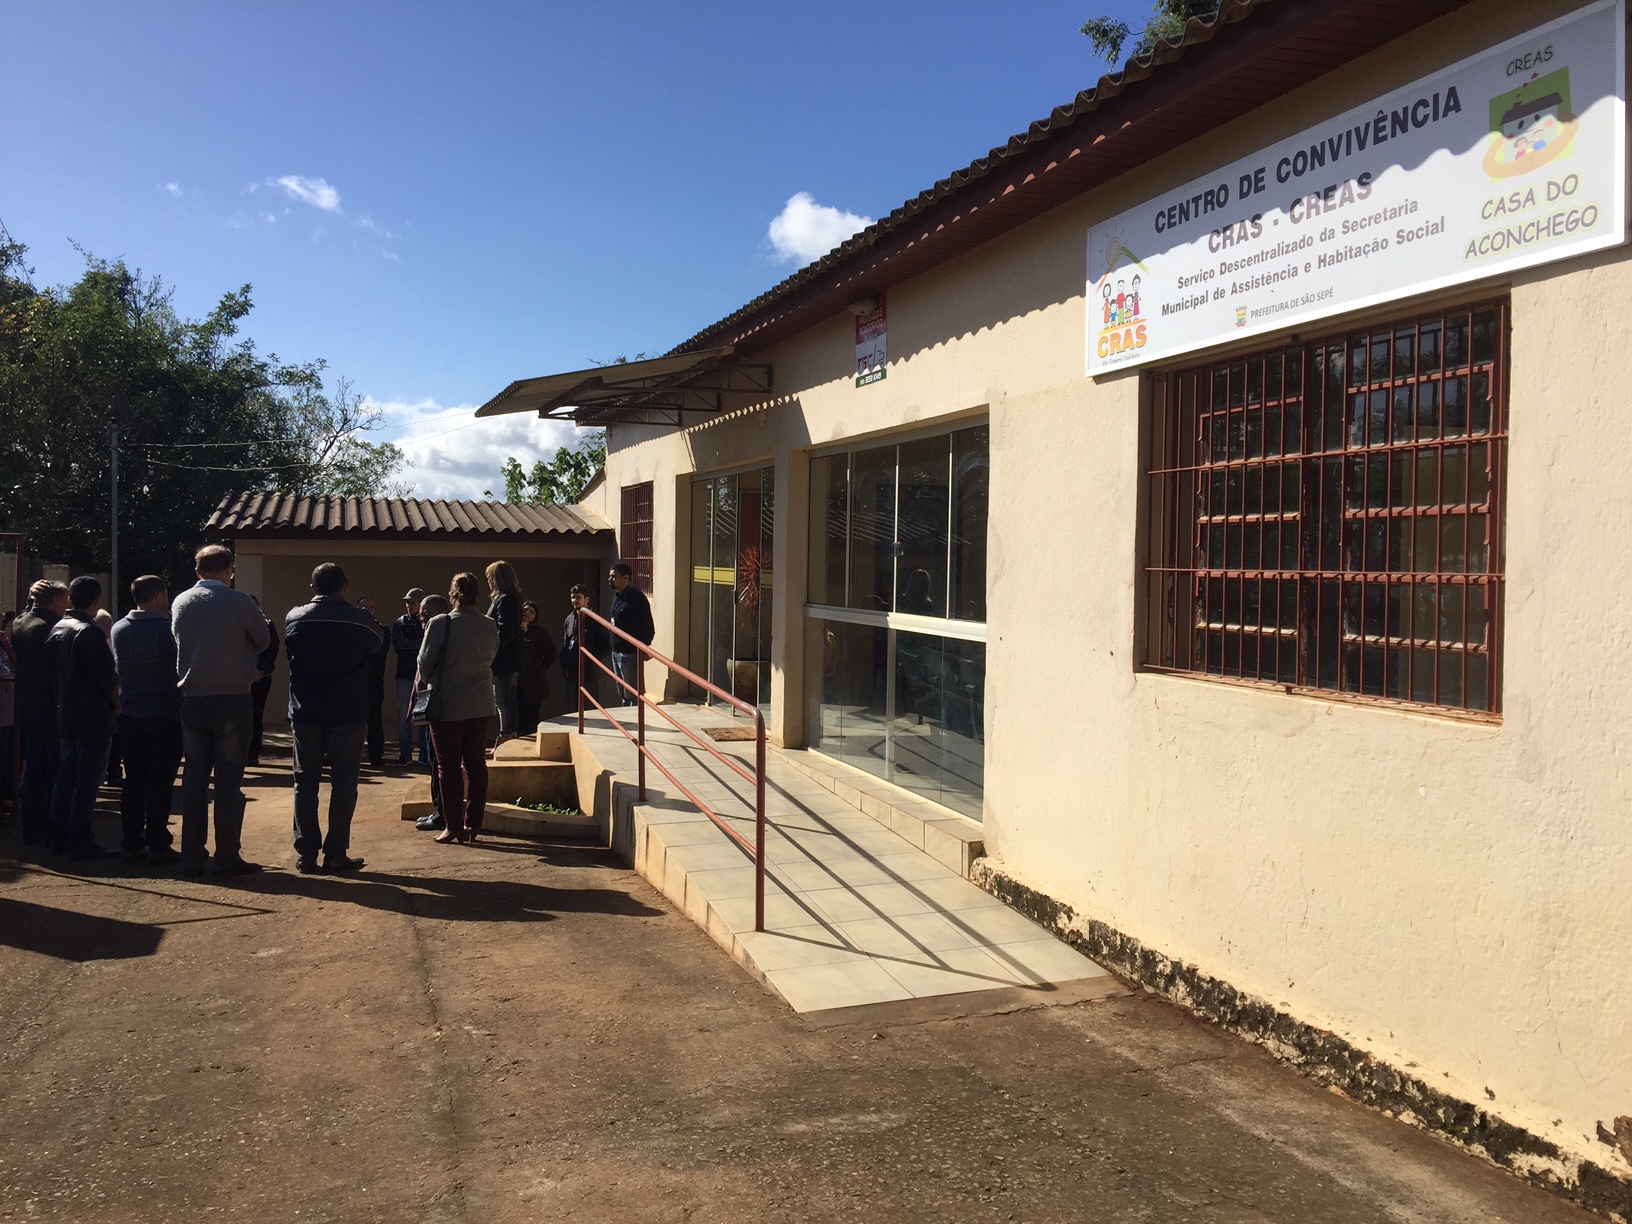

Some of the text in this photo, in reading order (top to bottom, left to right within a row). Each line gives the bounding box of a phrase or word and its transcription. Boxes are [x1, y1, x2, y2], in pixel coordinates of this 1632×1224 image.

[1506, 45, 1554, 77] CREAS
[1155, 85, 1462, 234] CENTRO DE CONVIVÊNCIA
[1208, 213, 1263, 253] CRAS
[1289, 171, 1373, 224] CREAS
[1481, 173, 1579, 220] CASA DO
[1177, 197, 1418, 289] Serviço Descentralizado da Secretaria
[1464, 205, 1598, 259] ACONCHEGO
[1161, 215, 1445, 317] Municipal de Assistência e Habitação Social
[1250, 286, 1334, 319] PREFEITURA DE SÃO SEPÉ
[1097, 324, 1147, 358] CRAS
